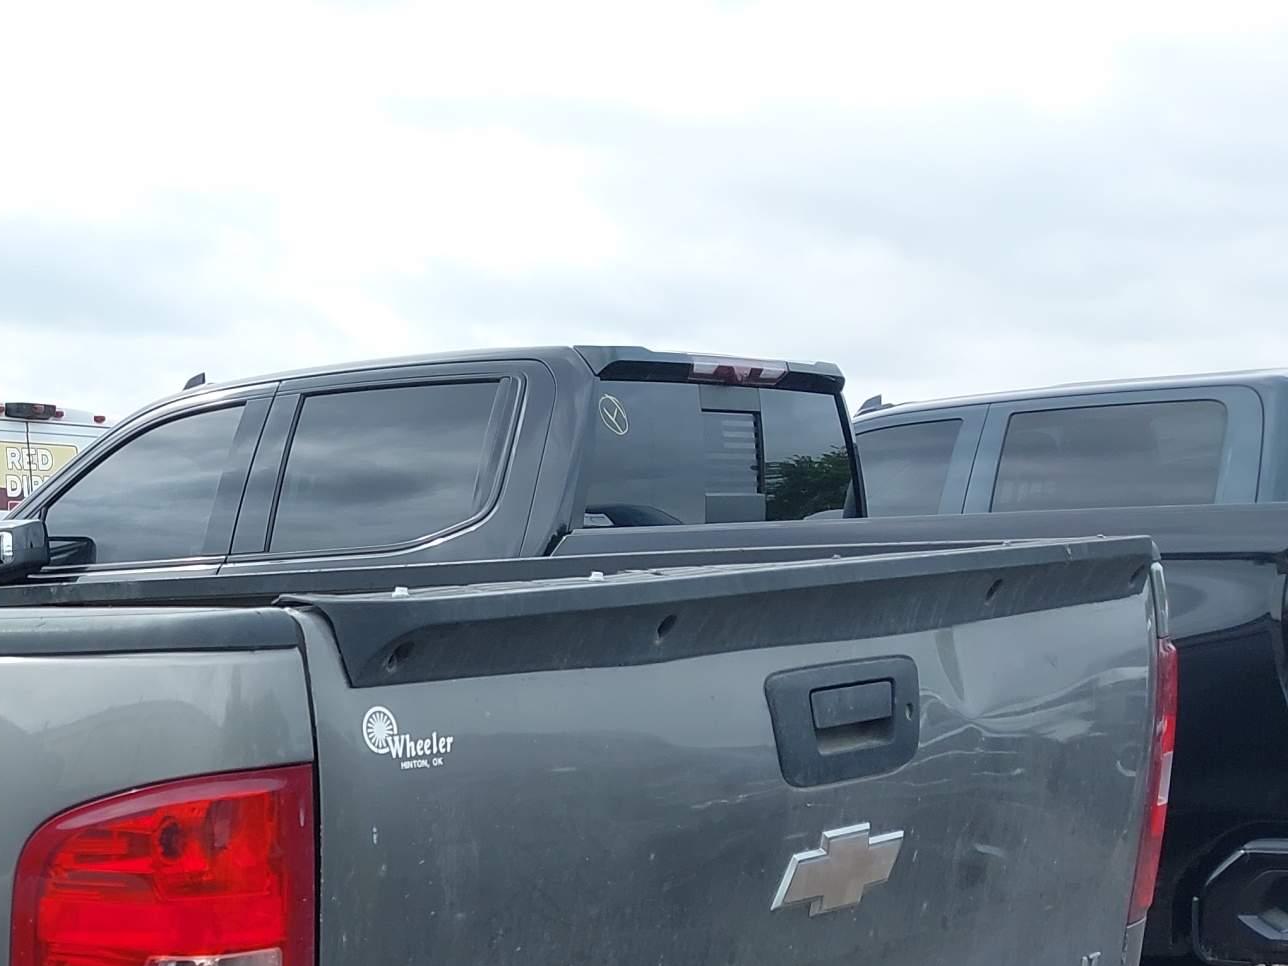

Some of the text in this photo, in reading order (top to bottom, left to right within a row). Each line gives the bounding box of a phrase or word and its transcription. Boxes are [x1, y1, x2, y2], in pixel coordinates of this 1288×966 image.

[6, 447, 53, 471] RED
[387, 731, 454, 759] Wheeler
[432, 757, 444, 767] OK
